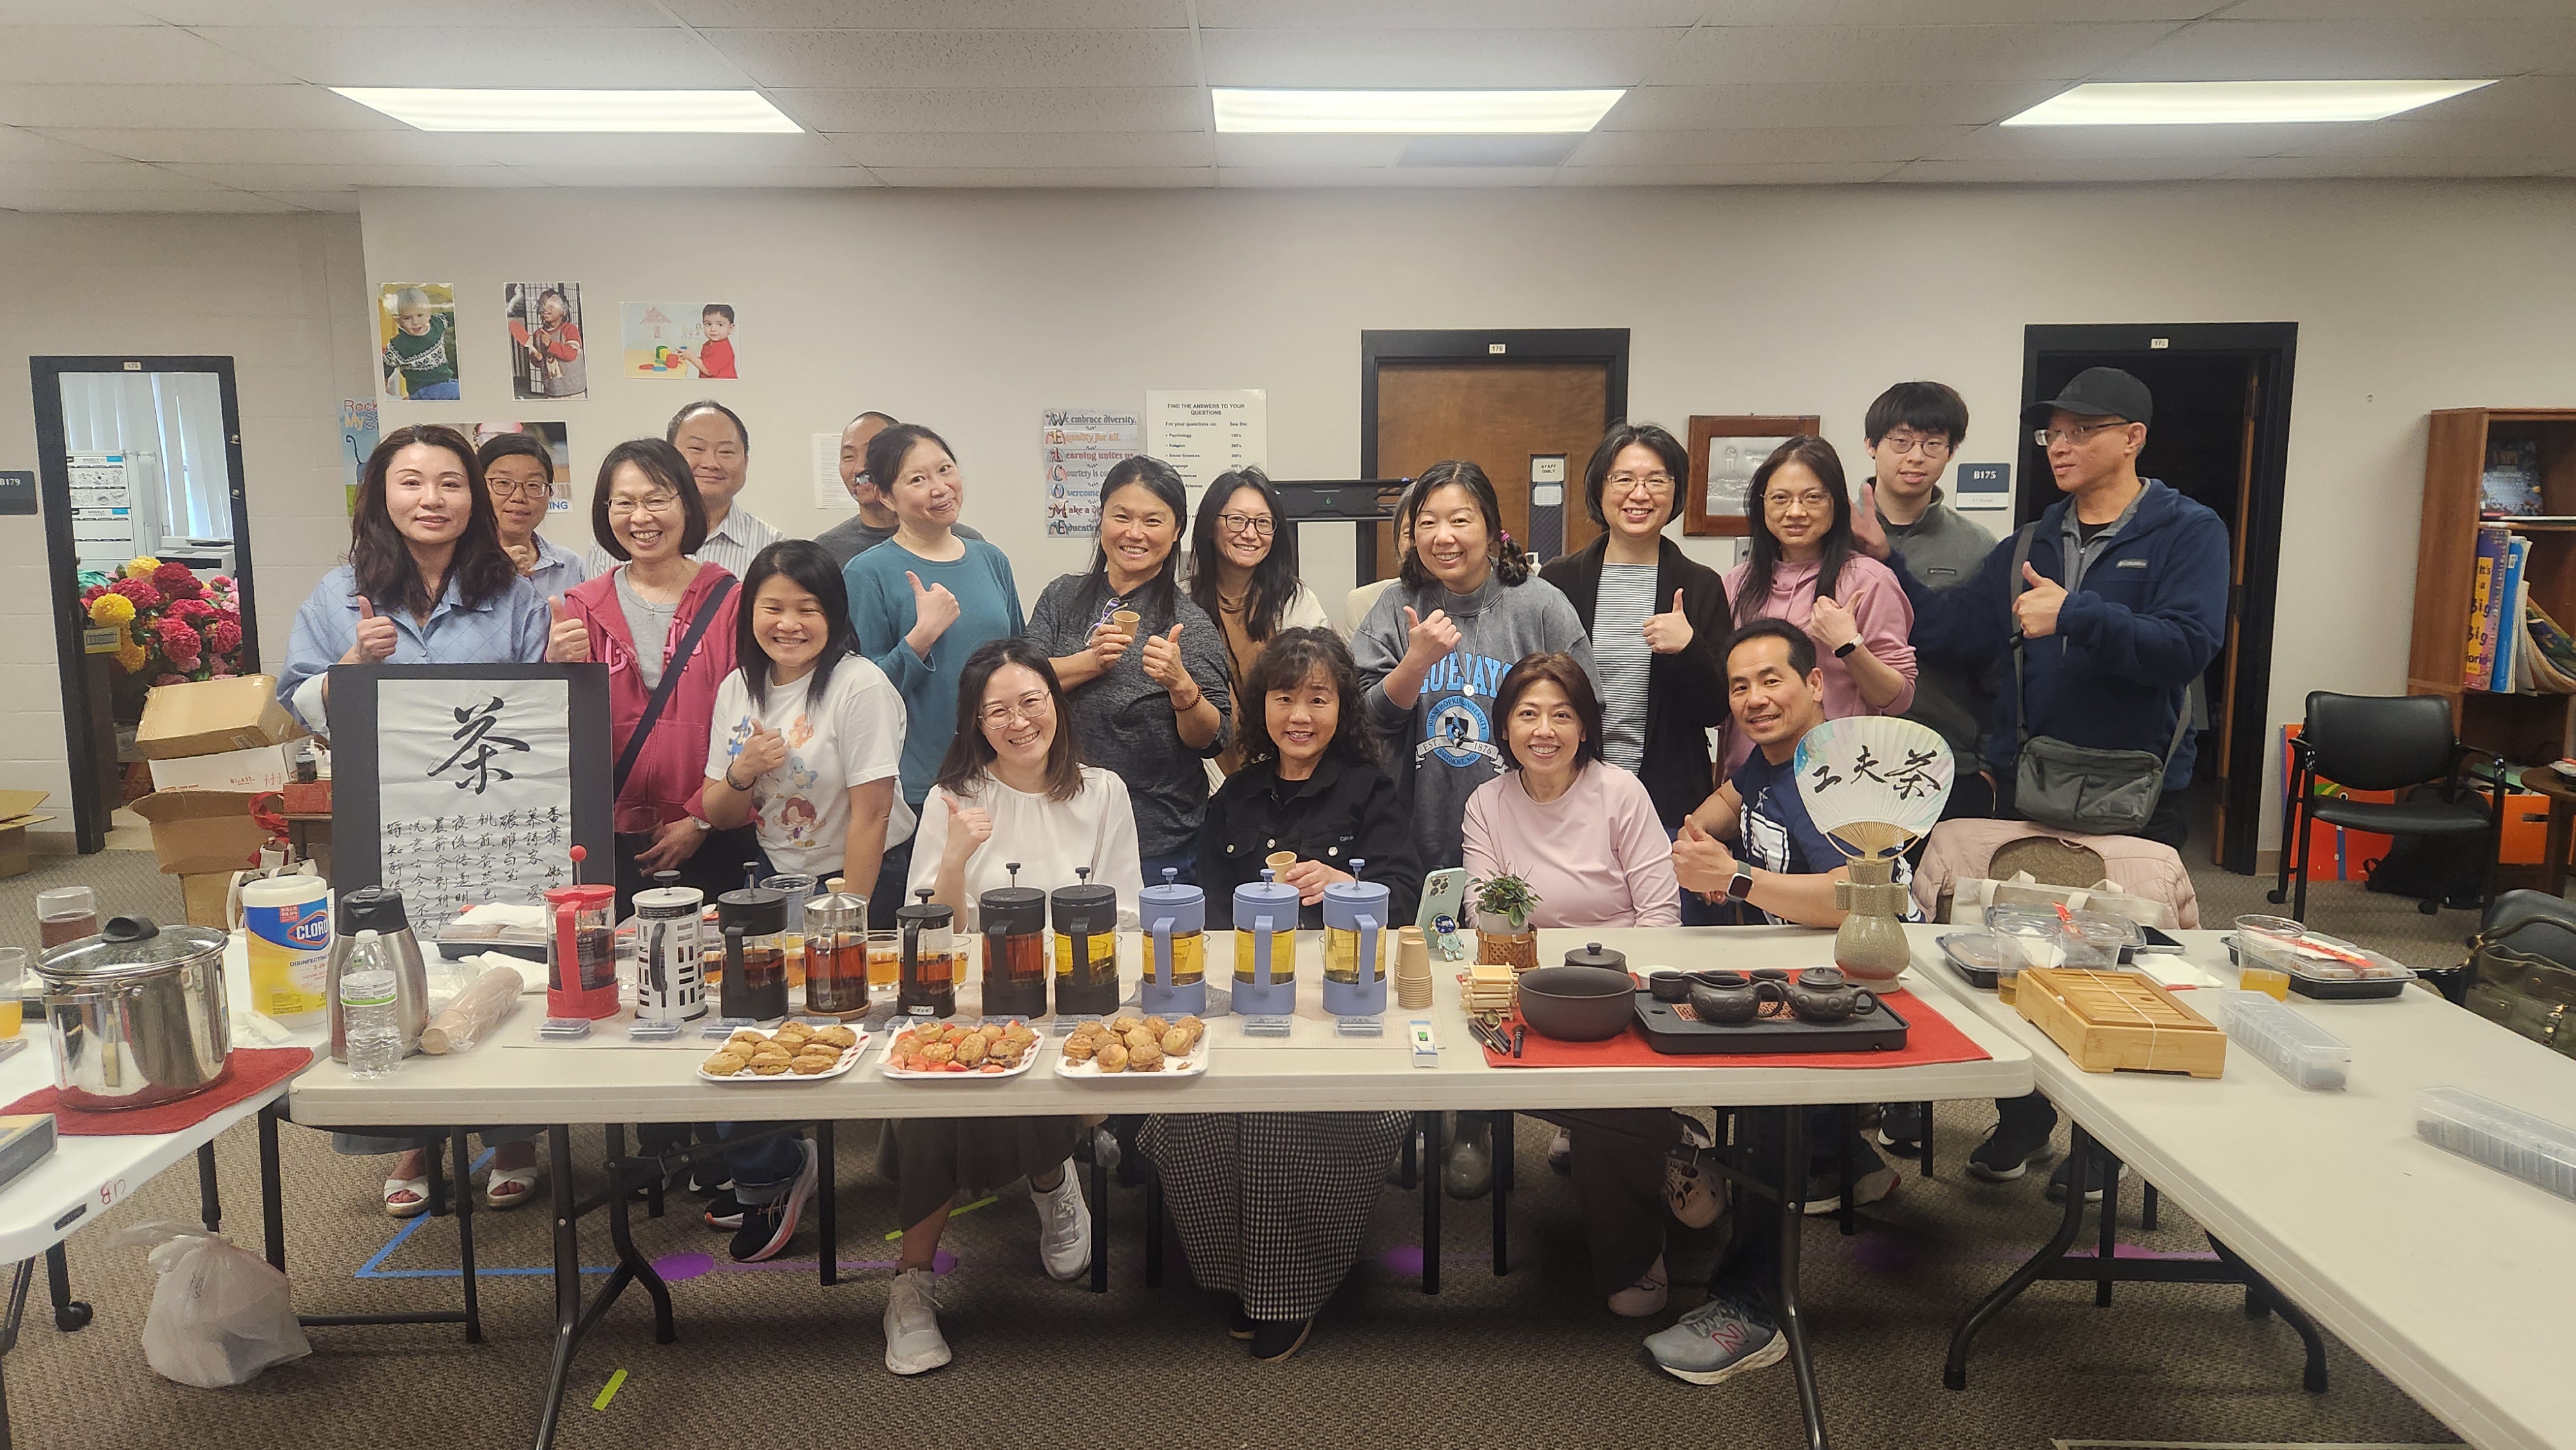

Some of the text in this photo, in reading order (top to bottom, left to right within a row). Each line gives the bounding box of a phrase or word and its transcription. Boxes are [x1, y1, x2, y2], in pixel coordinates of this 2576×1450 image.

[344, 399, 377, 412] Rock
[345, 413, 364, 431] My
[1045, 411, 1137, 426] We embrace diversity.
[1047, 429, 1093, 444] Equality
[1094, 433, 1107, 443] for
[1973, 470, 1996, 480] B175
[1051, 484, 1100, 498] Overcome
[549, 501, 569, 510] ING
[1048, 500, 1084, 518] Make
[2479, 564, 2491, 575] It's
[2467, 652, 2488, 665] orld
[1428, 707, 1440, 728] JOHNS
[426, 695, 531, 795] 茶
[1423, 739, 1441, 751] EST.
[1473, 742, 1492, 755] 1876
[296, 918, 328, 940] CLORO
